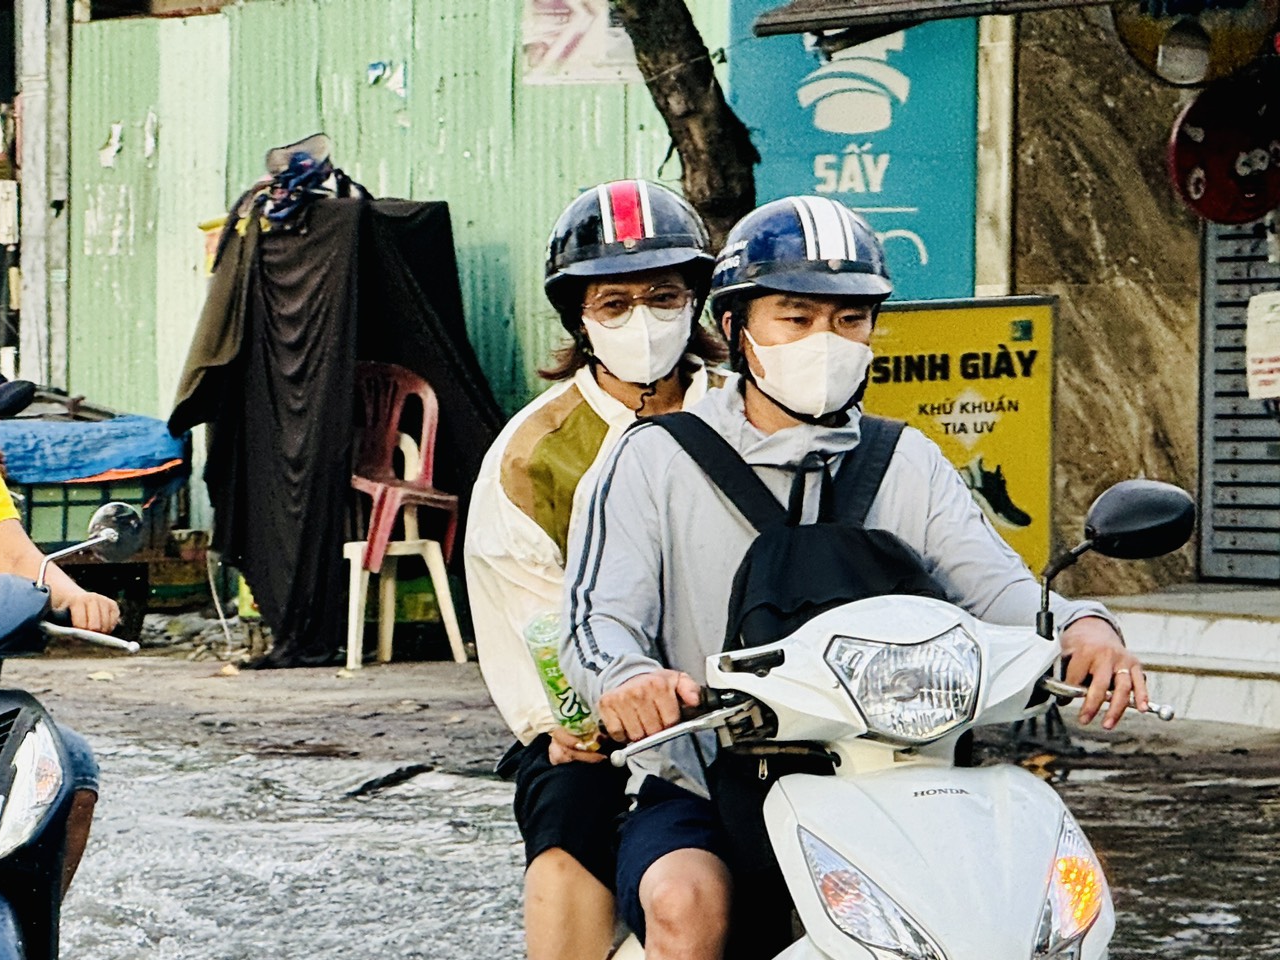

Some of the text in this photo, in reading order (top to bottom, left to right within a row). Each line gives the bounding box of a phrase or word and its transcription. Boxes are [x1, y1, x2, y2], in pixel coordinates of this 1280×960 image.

[814, 142, 890, 193] SẤY
[872, 344, 1038, 384] SINH GIÀY
[942, 421, 996, 435] TIA UV
[913, 788, 970, 798] HONDA
